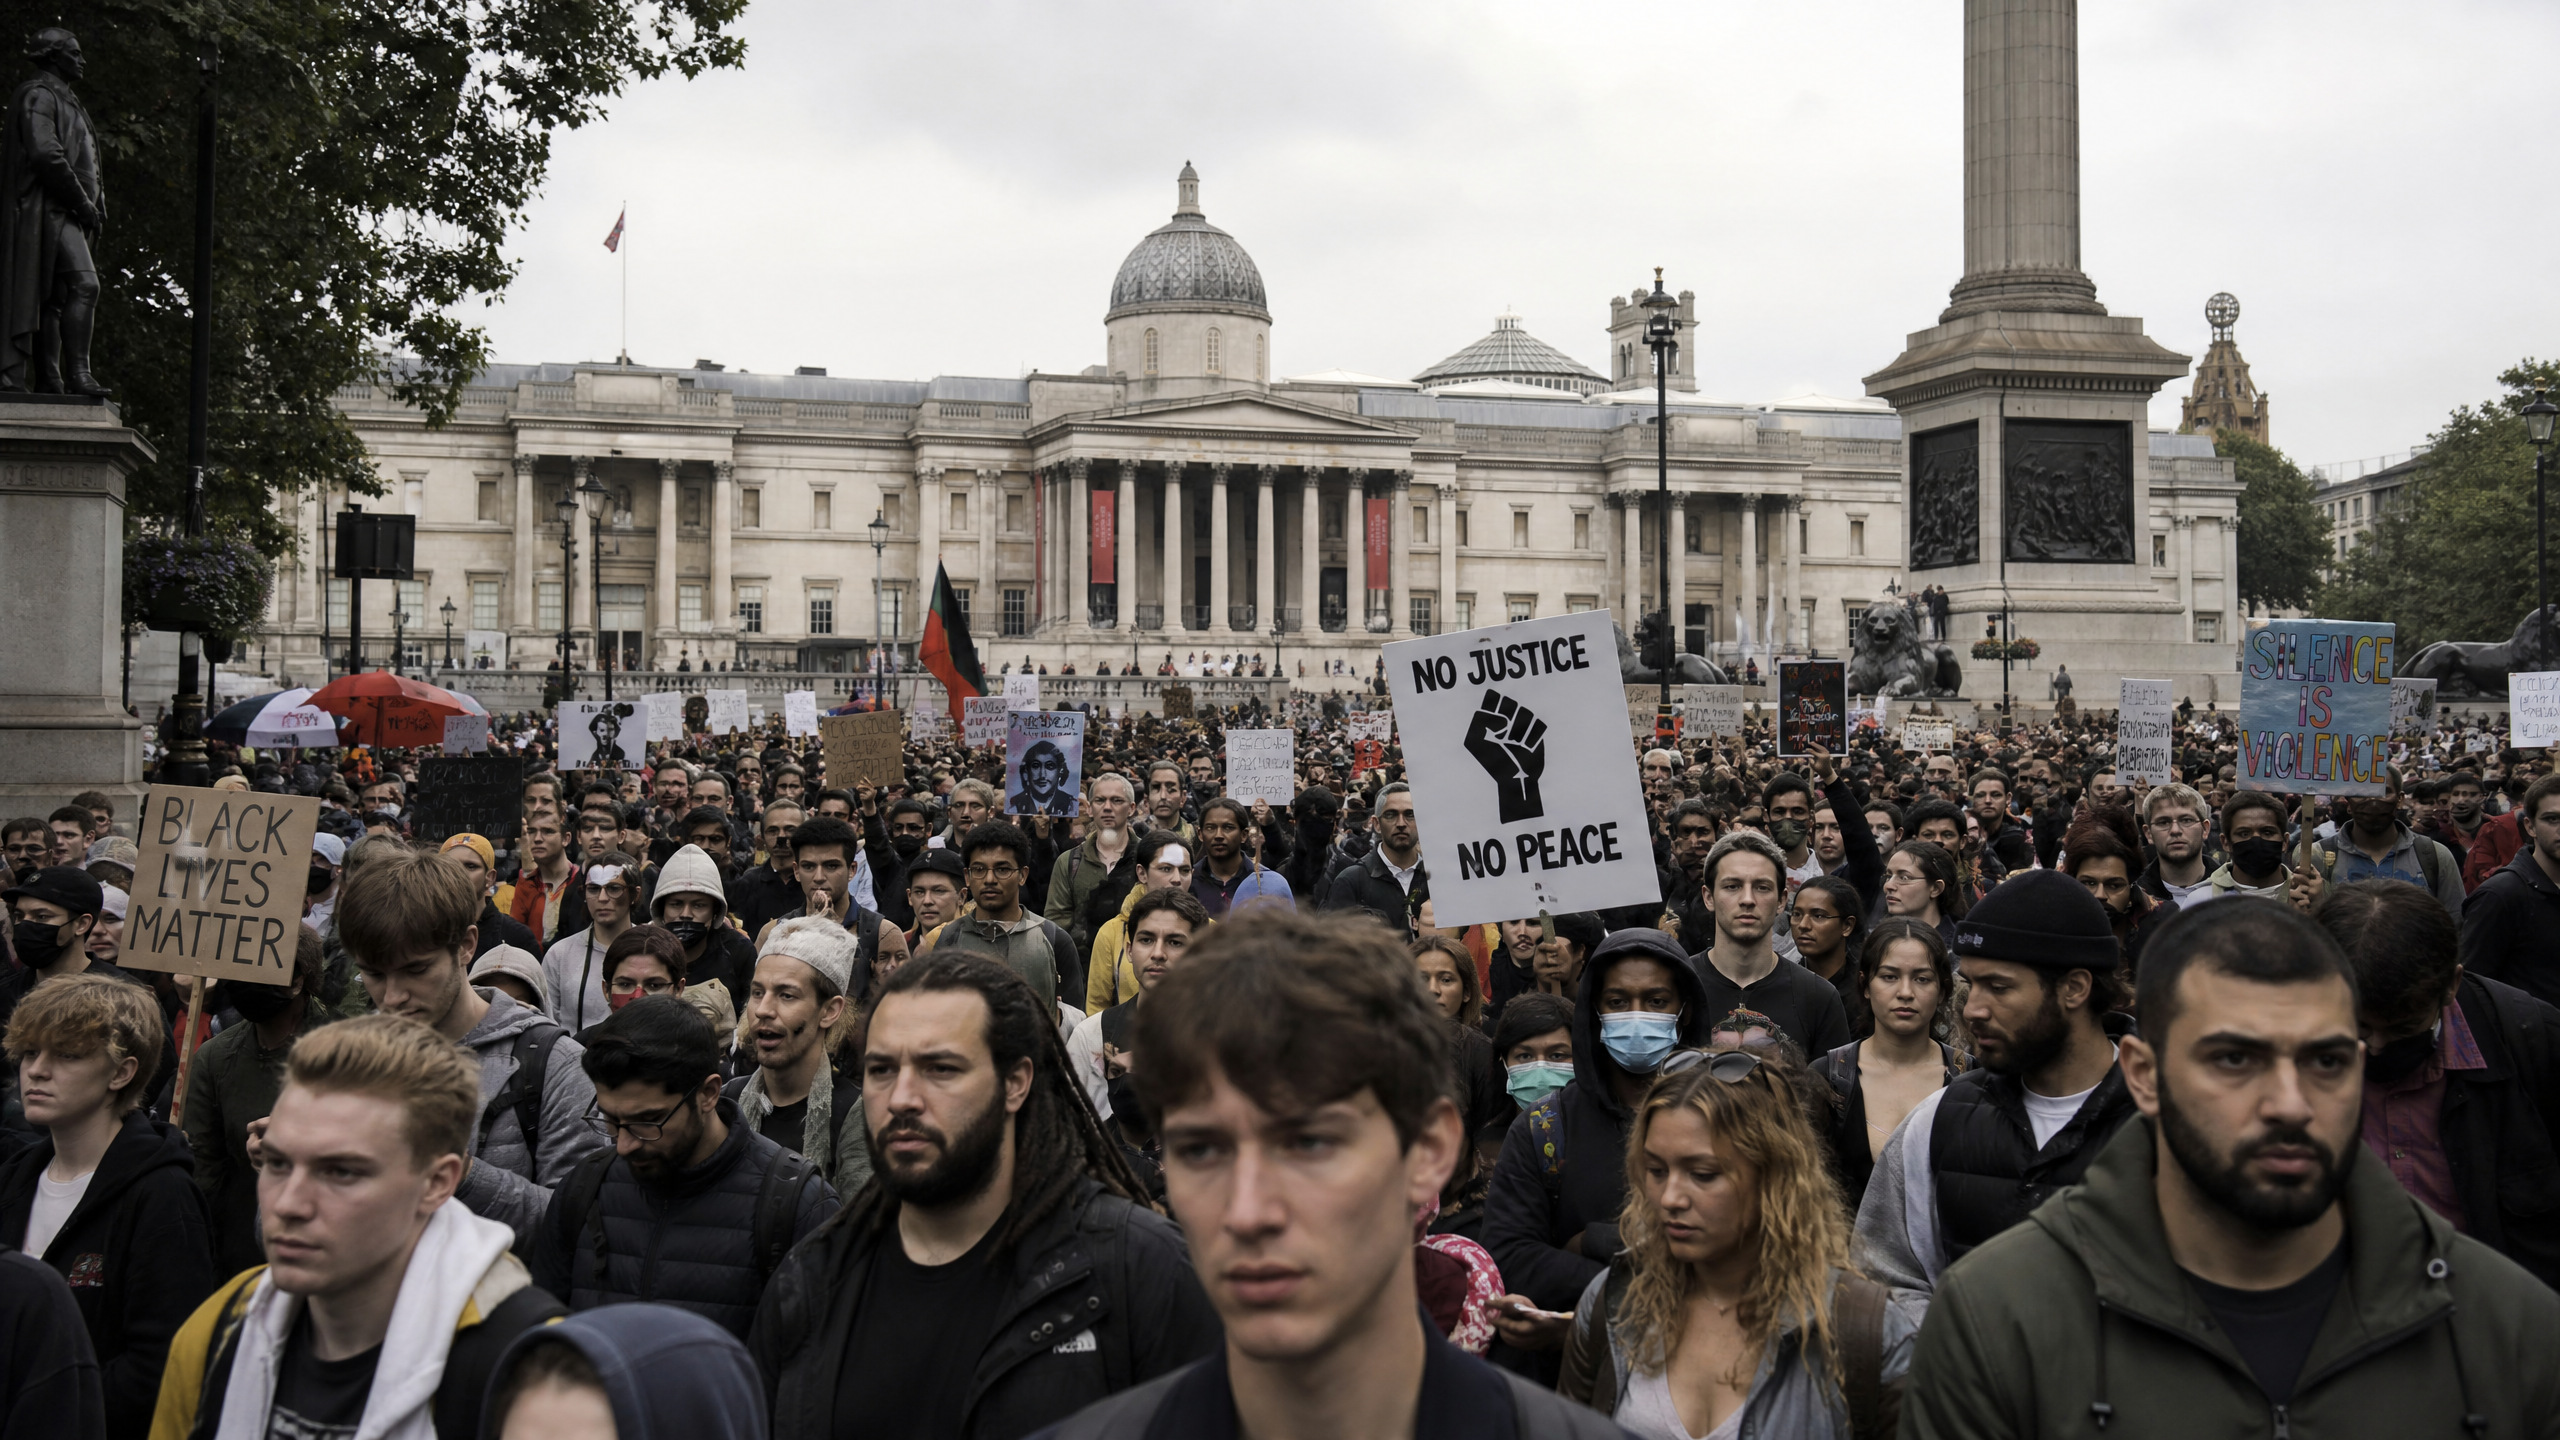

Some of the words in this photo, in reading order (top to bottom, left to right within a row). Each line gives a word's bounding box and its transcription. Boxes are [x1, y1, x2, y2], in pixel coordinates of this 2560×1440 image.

[1411, 655, 1457, 694] NO
[1467, 634, 1590, 686] JUSTICE
[2249, 631, 2393, 684] SILENCE
[2298, 685, 2332, 729] IS
[2242, 730, 2386, 783] VIOLENCE
[158, 796, 293, 857] BLACK
[1457, 838, 1506, 881] NO
[1516, 821, 1623, 872] PEACE
[158, 853, 271, 908] LIVES
[129, 904, 284, 968] MATTER
